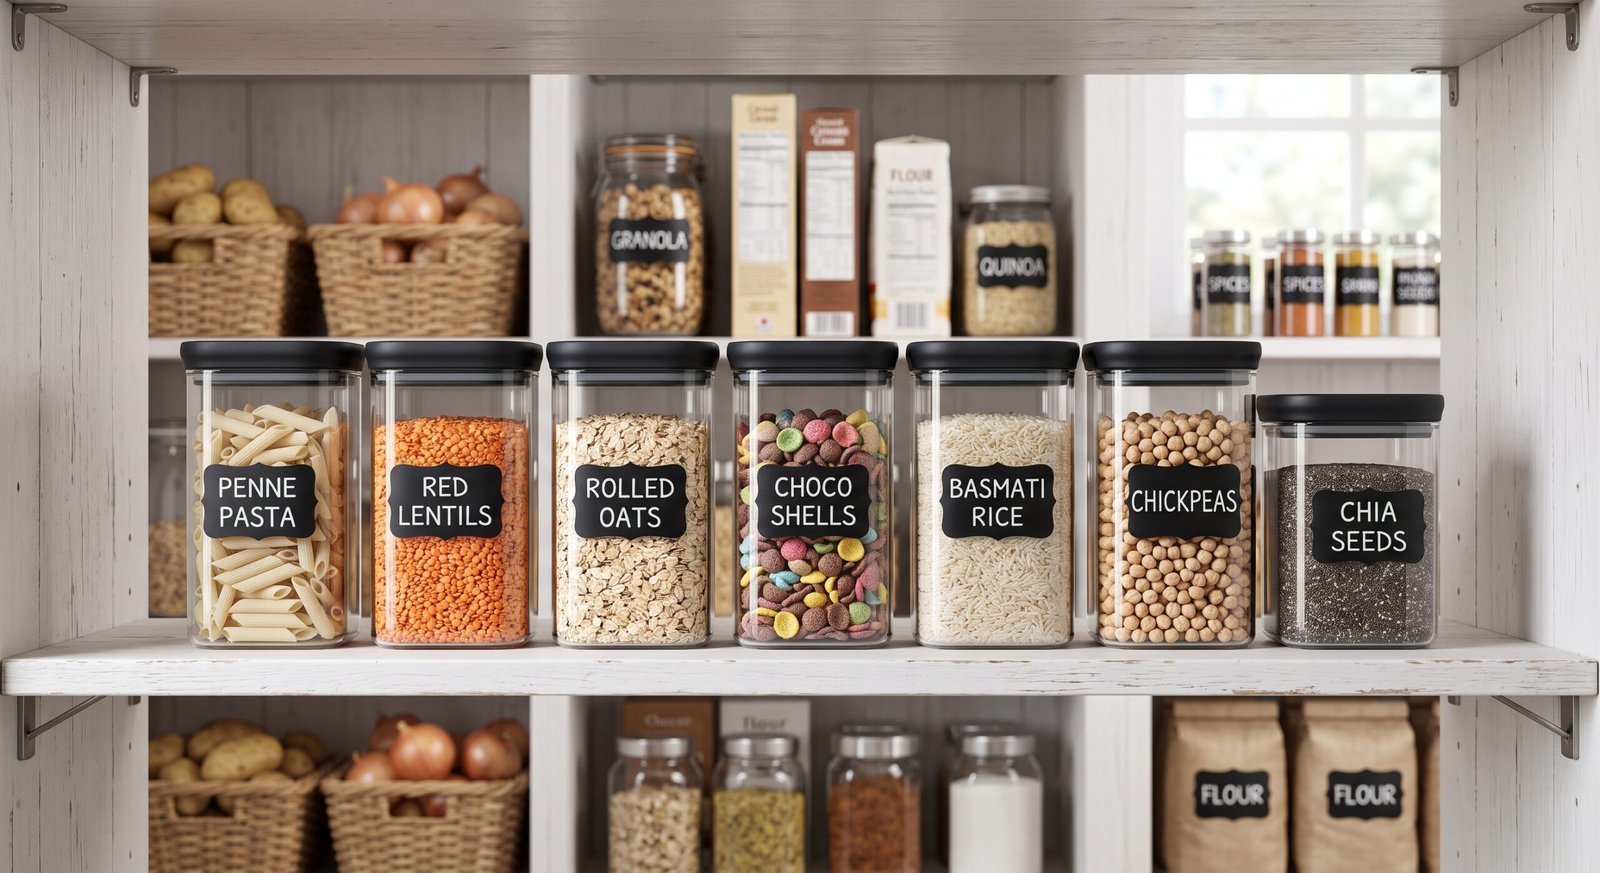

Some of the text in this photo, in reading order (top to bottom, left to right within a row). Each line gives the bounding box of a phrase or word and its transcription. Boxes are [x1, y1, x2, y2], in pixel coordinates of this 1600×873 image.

[890, 168, 933, 183] FLOUR
[611, 229, 688, 251] GRANOLA
[979, 256, 1046, 279] QUINOA
[1207, 275, 1250, 293] SPICES
[1282, 275, 1324, 293] SPICES
[218, 476, 297, 499] PENNE
[422, 476, 468, 497] RED
[586, 477, 675, 499] ROLLED
[774, 476, 852, 498] CHOCO
[950, 478, 1046, 499] BASMATI
[1131, 489, 1238, 513] CHICKPEAS
[1340, 501, 1397, 523] CHIA
[219, 505, 296, 528] PASTA
[398, 505, 492, 527] LENTILS
[599, 506, 661, 529] OATS
[770, 504, 857, 526] SHELLS
[972, 506, 1024, 527] RICE
[1331, 530, 1407, 553] SEEDS
[1201, 783, 1264, 806] FLOUR
[1333, 783, 1397, 806] FLOUR
